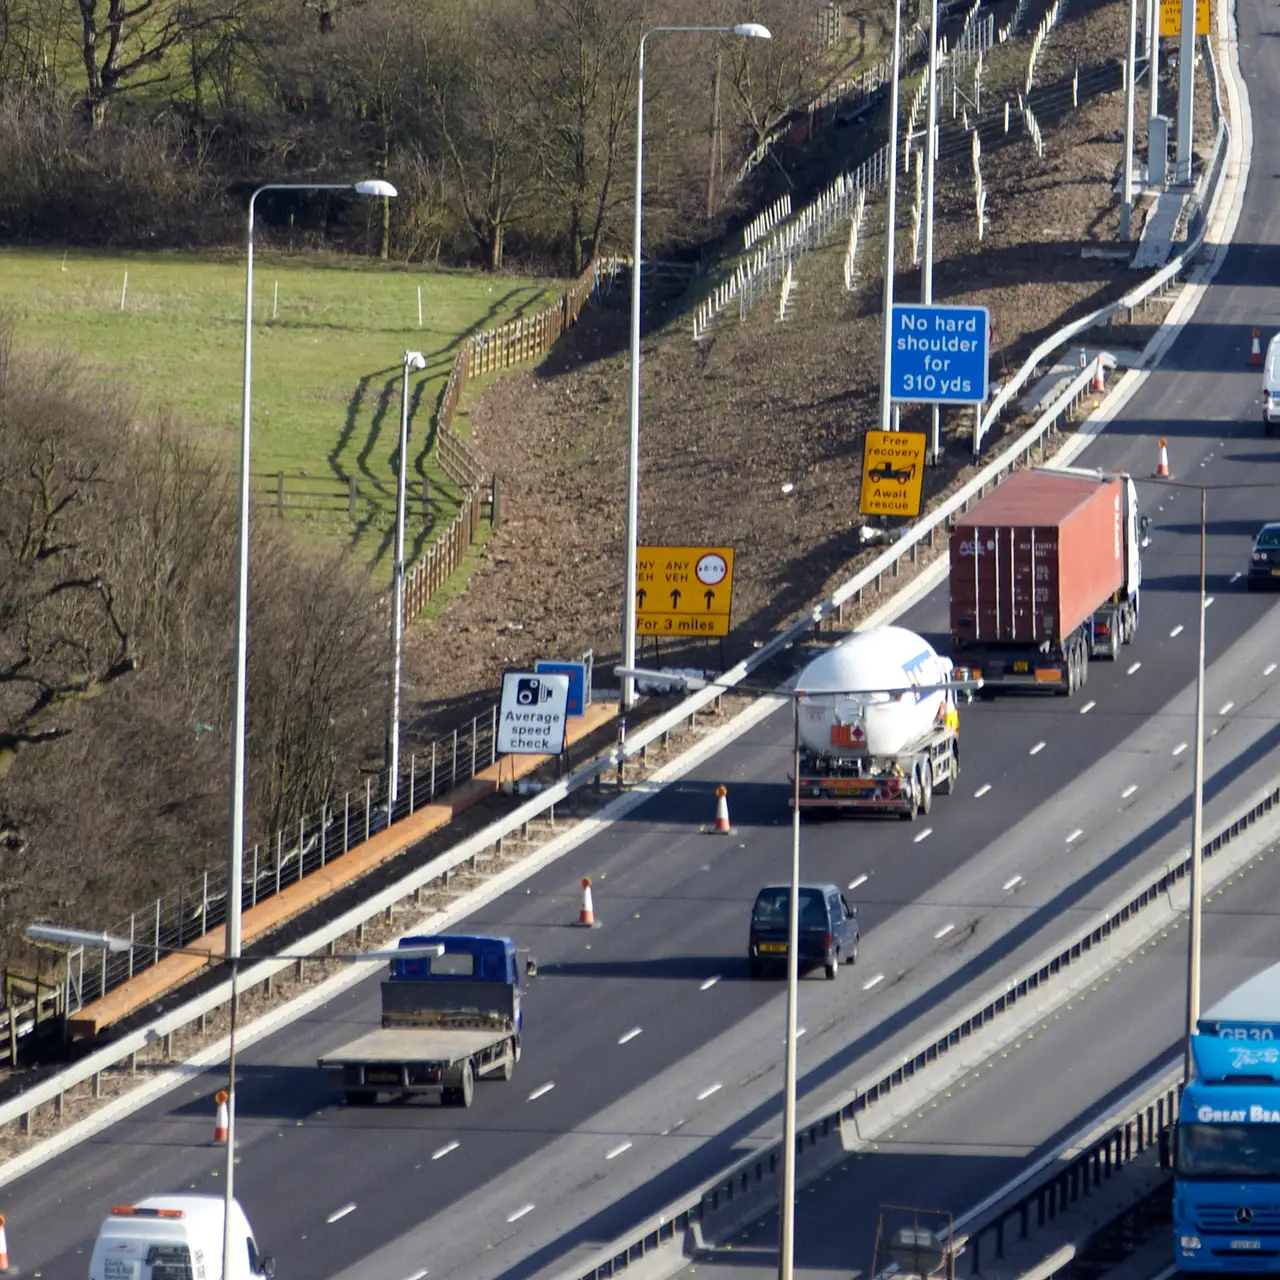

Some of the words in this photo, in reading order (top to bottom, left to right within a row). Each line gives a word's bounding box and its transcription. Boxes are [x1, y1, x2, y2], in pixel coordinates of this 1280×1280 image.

[901, 314, 928, 331] No
[935, 315, 976, 332] hard
[897, 334, 978, 352] shoulder
[924, 354, 951, 372] for
[903, 374, 936, 391] 310
[940, 375, 972, 395] yds
[882, 435, 909, 446] Free
[868, 447, 920, 459] recovery
[873, 488, 907, 499] Await
[869, 500, 909, 510] rescue
[636, 561, 655, 570] NY
[666, 561, 690, 570] ANY
[636, 573, 654, 582] EH
[665, 573, 688, 582] VEH
[637, 618, 659, 630] For
[664, 618, 673, 630] 3
[678, 617, 715, 631] miles
[505, 710, 560, 724] Average
[511, 725, 552, 738] speed
[510, 737, 550, 749] check
[1197, 1104, 1247, 1123] GREAT
